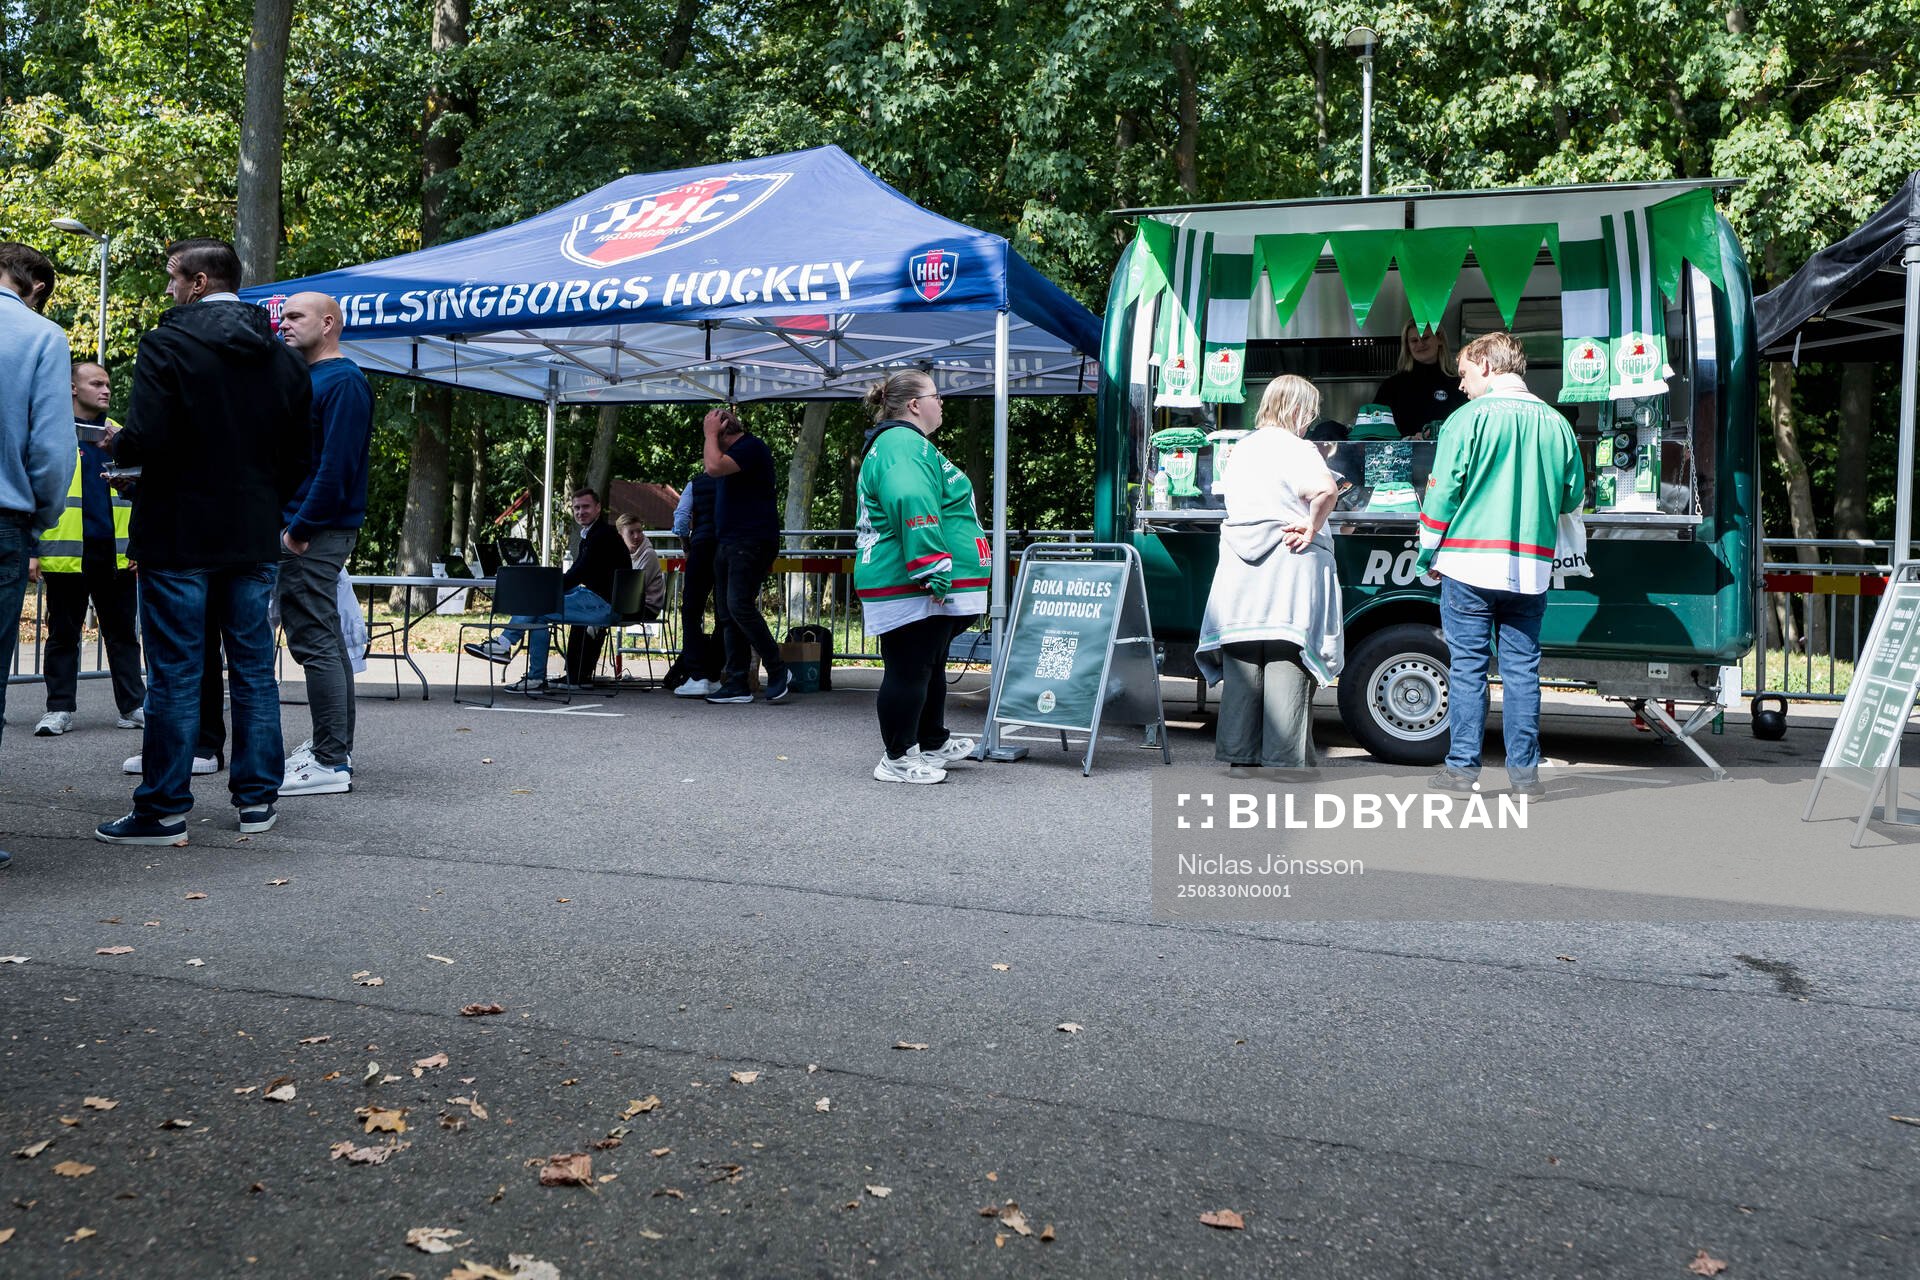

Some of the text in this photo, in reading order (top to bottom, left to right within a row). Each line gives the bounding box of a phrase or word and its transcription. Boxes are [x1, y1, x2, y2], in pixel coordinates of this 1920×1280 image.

[591, 193, 740, 234] HHC
[595, 225, 693, 242] HELSINGBORG
[916, 262, 950, 281] HHC
[662, 259, 866, 306] HOCKEY
[1361, 540, 1441, 587] RÖ
[1032, 577, 1112, 597] BOKA RÖGLES
[1032, 600, 1103, 619] FOODTRUCK
